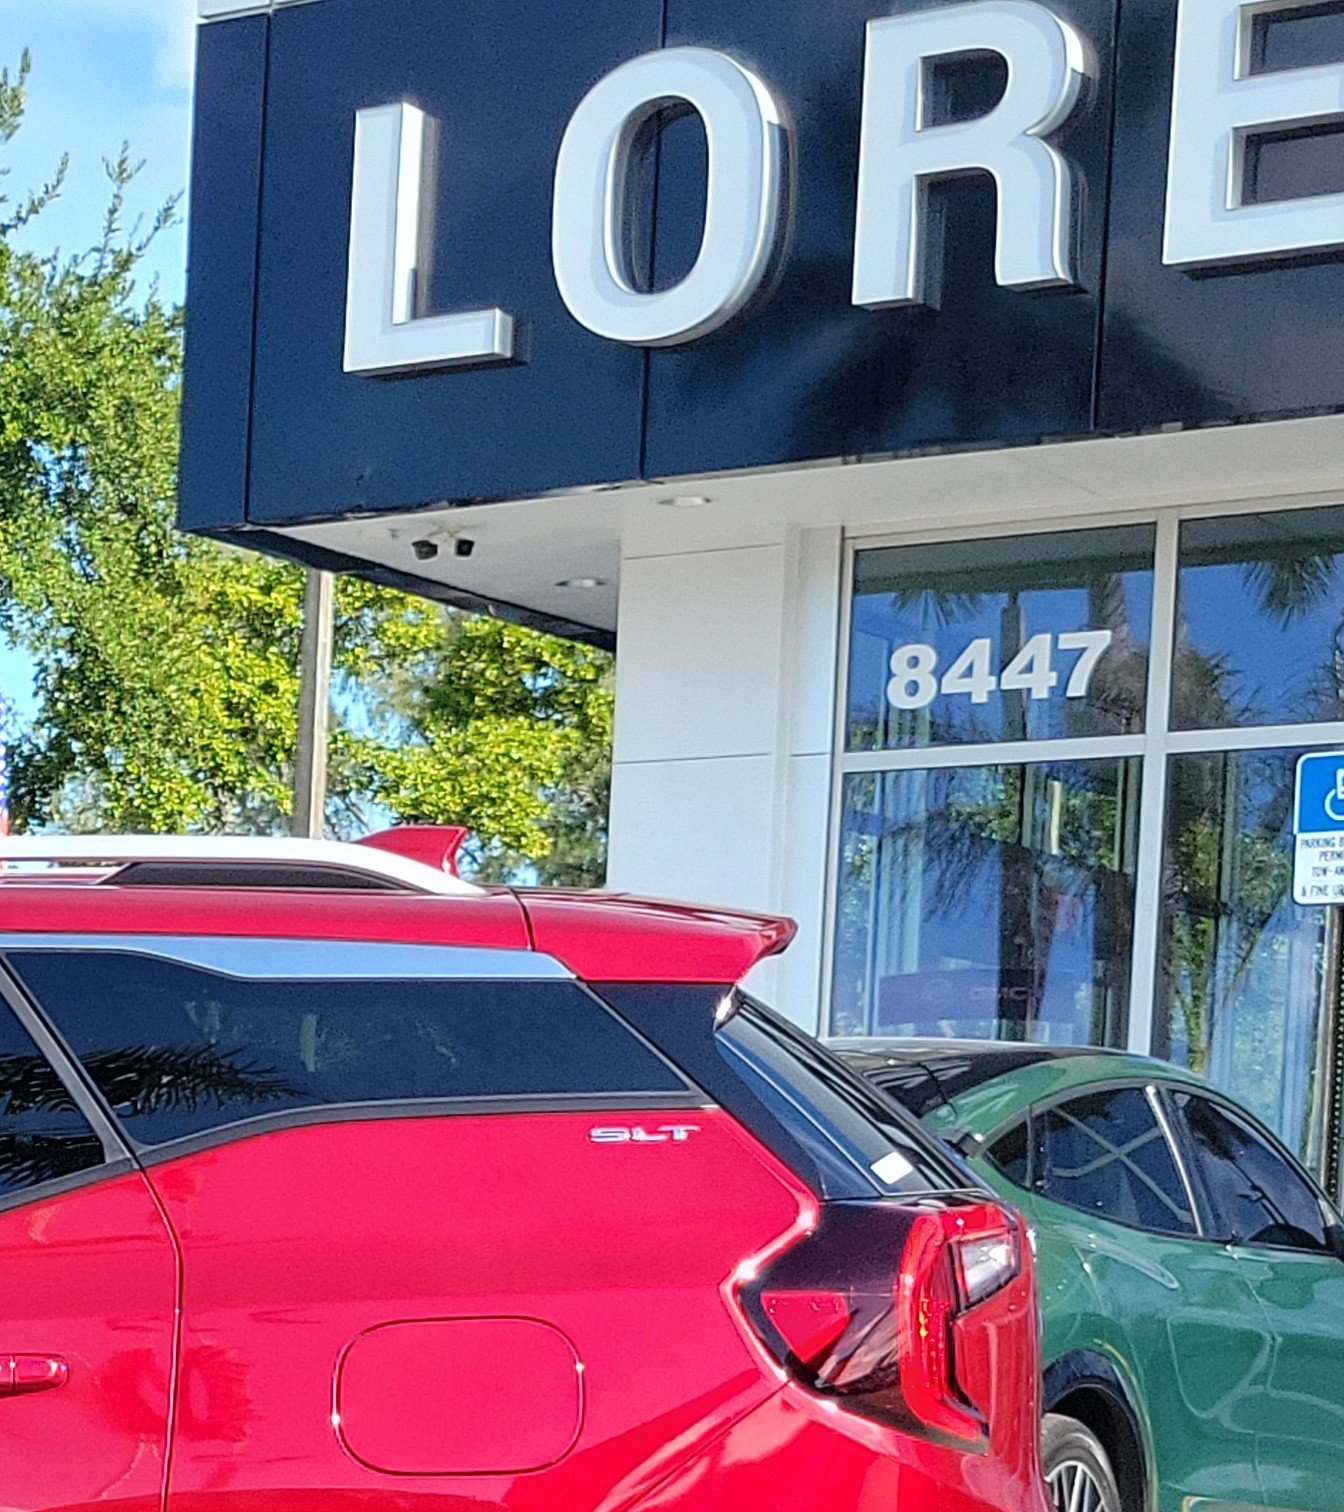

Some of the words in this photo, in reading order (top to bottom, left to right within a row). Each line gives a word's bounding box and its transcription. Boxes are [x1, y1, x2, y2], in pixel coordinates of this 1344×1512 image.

[343, 0, 1344, 376] LORE
[887, 630, 1112, 709] 8447
[590, 1125, 702, 1143] SLT
